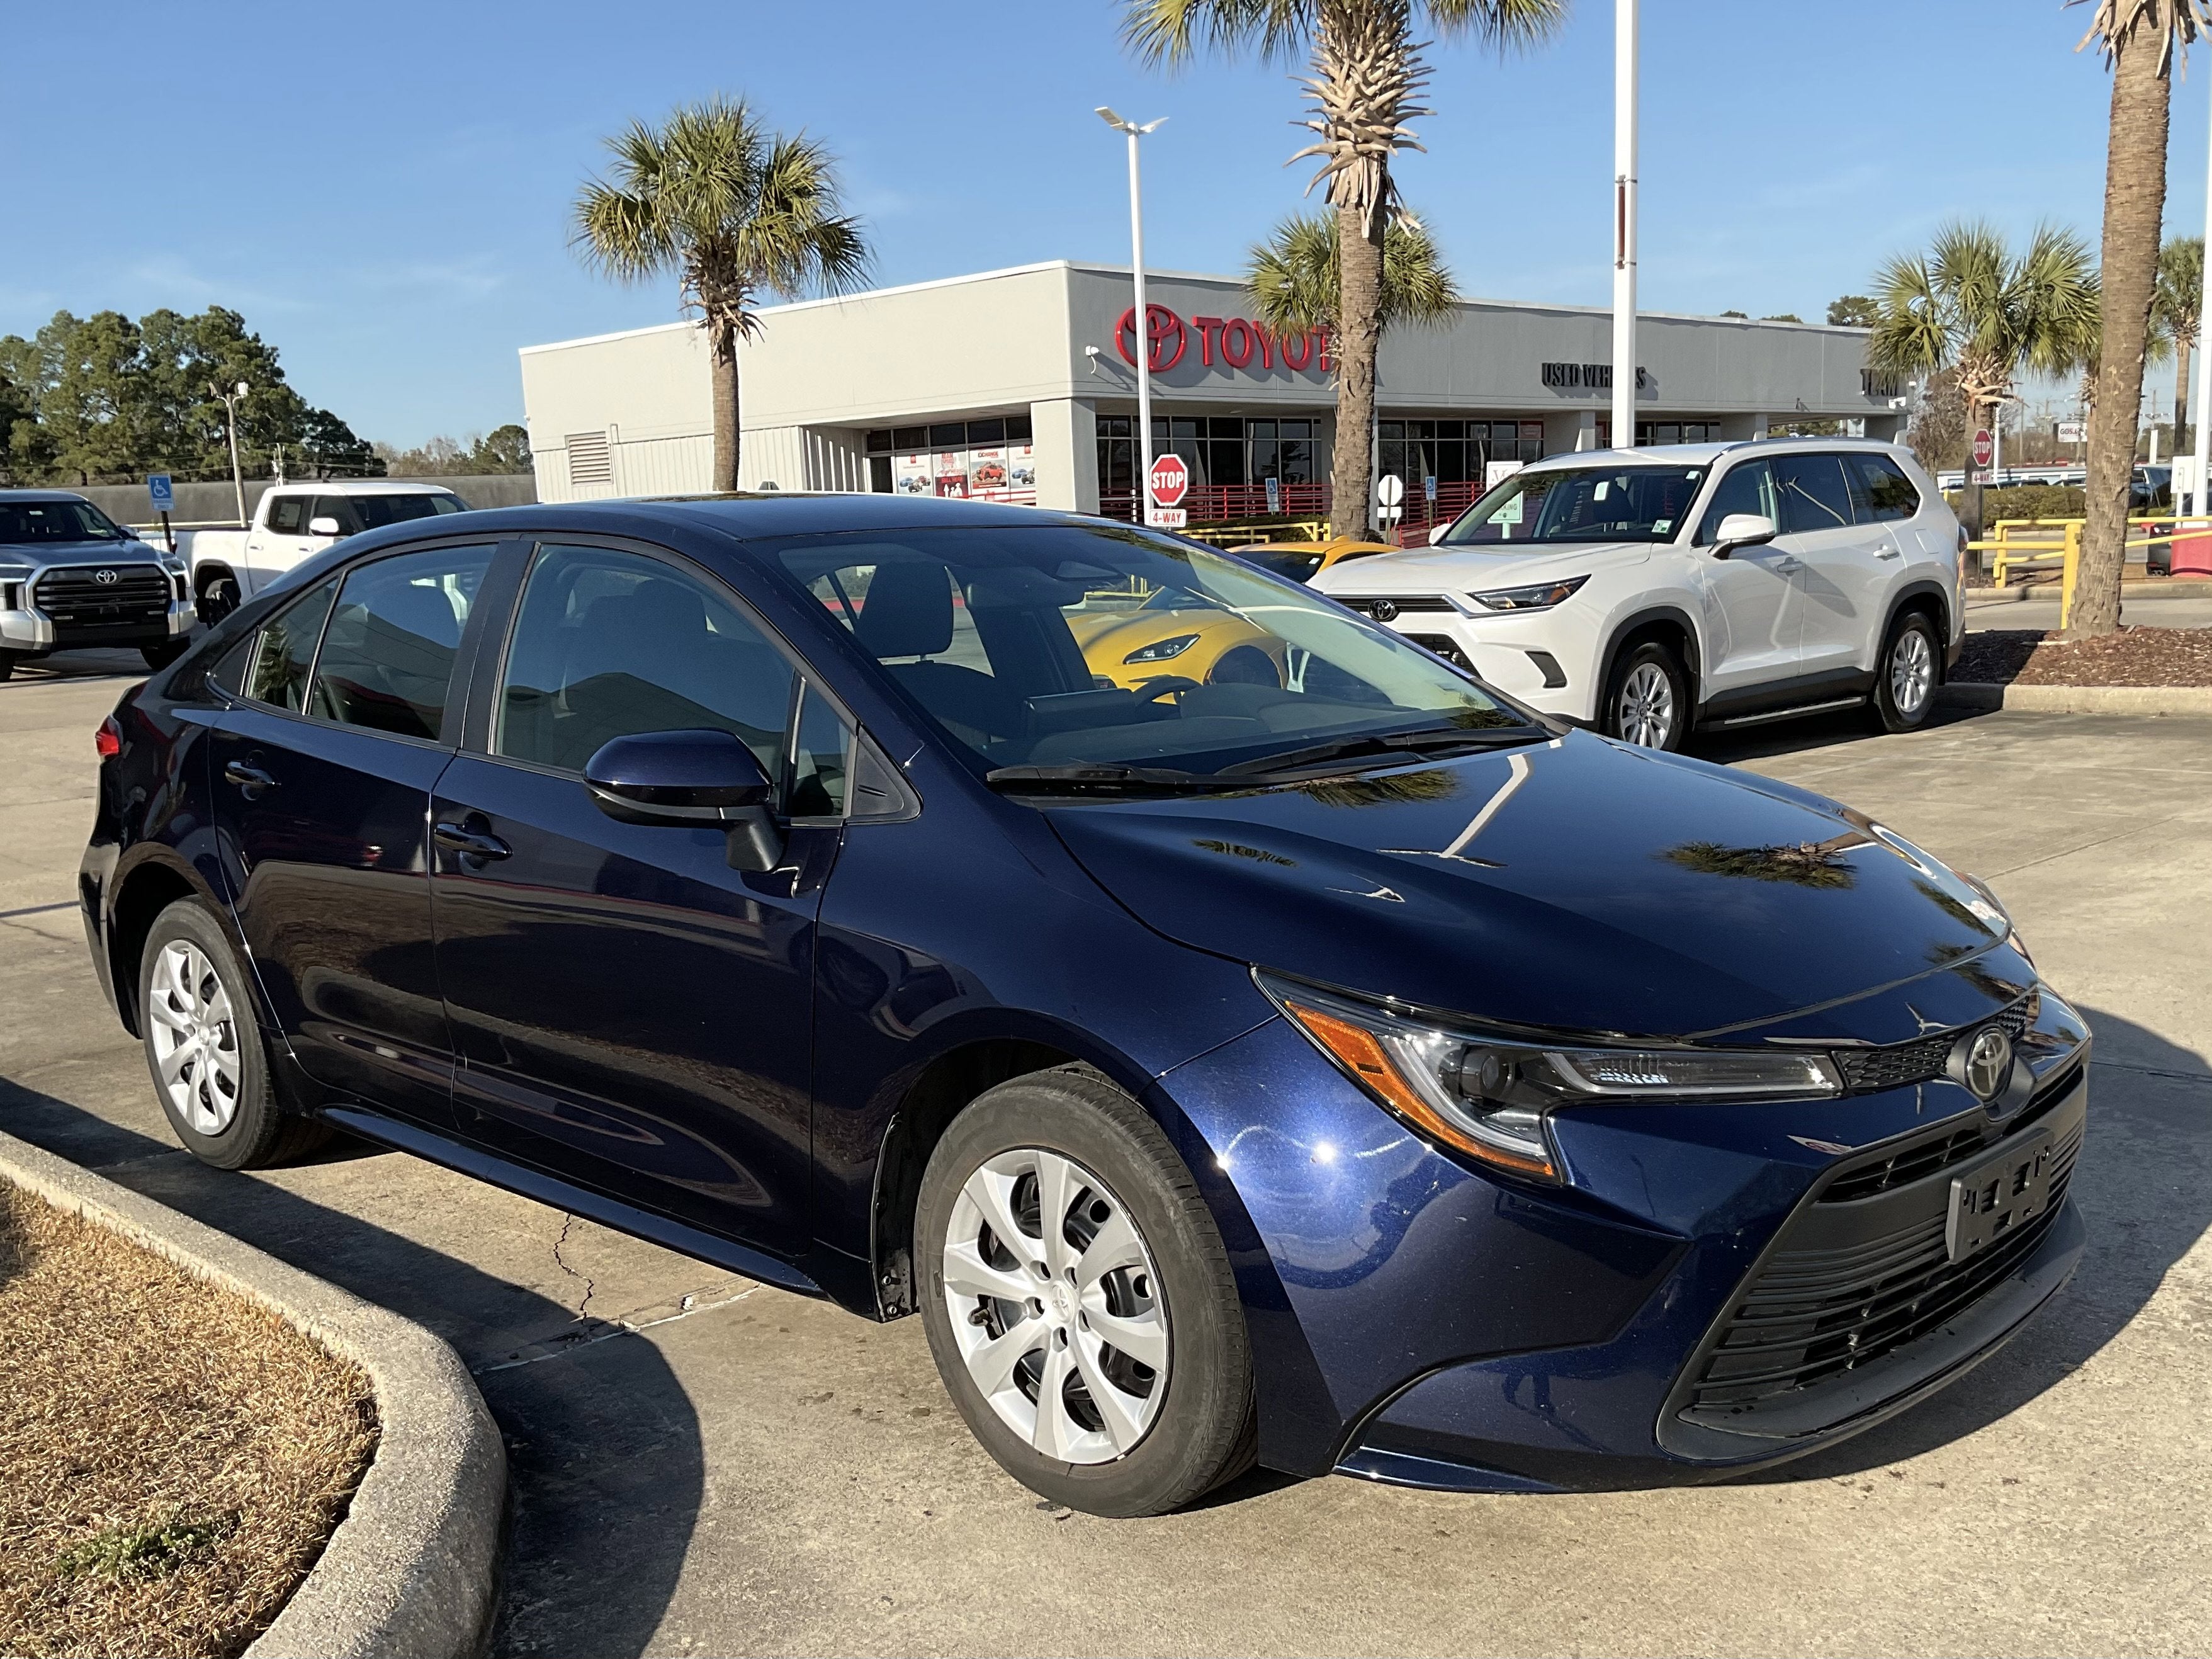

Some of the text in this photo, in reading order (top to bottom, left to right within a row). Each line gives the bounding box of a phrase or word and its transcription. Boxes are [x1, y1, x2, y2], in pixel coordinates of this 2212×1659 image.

[1192, 315, 1331, 371] TOYOT
[1542, 363, 1647, 388] USED VEHS
[1974, 441, 1991, 454] STOP
[1152, 471, 1184, 489] STOP
[1153, 512, 1182, 523] 4-WAY
